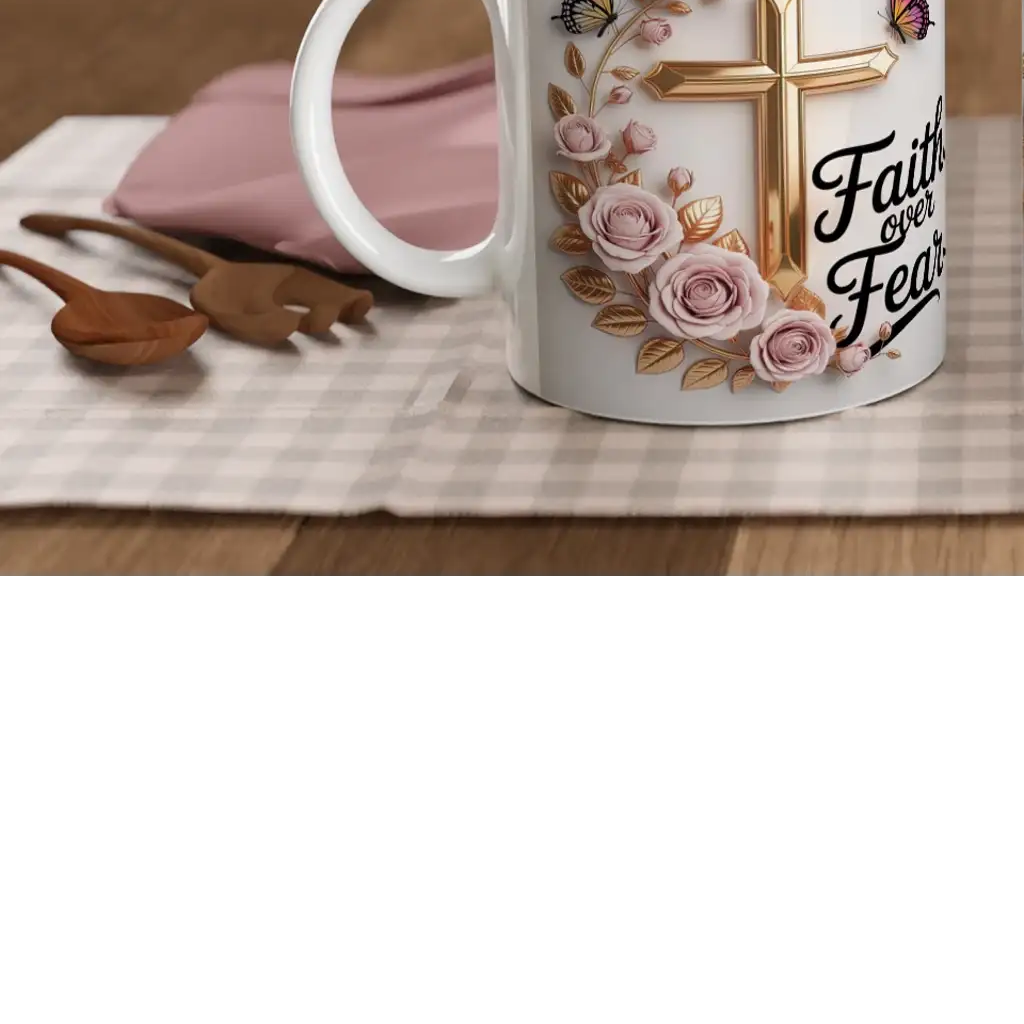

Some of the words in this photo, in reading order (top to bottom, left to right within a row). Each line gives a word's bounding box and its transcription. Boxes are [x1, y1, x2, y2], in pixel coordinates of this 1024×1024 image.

[811, 95, 945, 243] Faith
[880, 188, 936, 243] over
[827, 229, 945, 349] Fear
